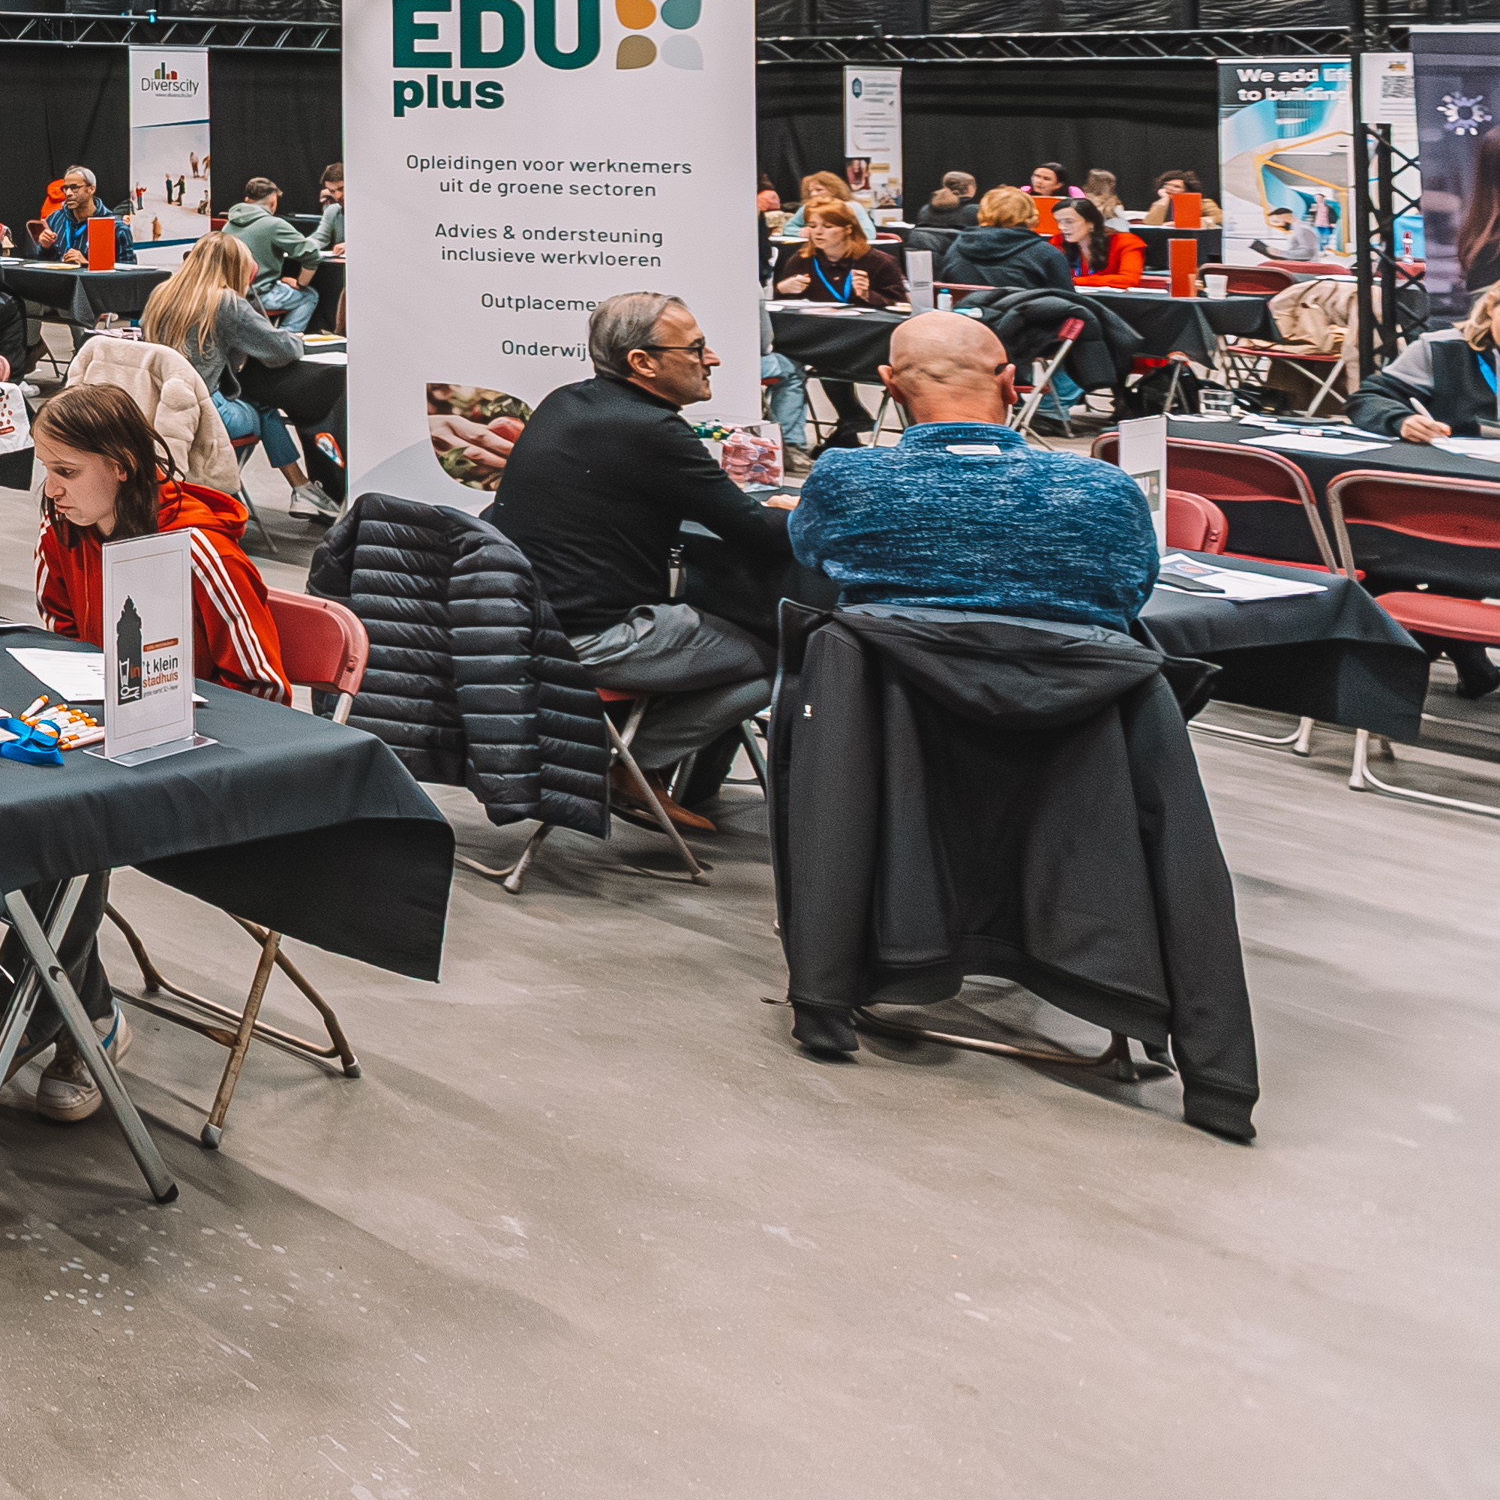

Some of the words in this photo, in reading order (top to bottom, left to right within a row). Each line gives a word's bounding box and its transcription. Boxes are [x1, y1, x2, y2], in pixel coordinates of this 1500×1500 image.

[1236, 68, 1275, 83] We
[1277, 68, 1320, 83] add
[141, 77, 200, 95] Diverscity
[393, 74, 505, 117] plus
[1237, 88, 1263, 102] to
[406, 155, 517, 174] Opleidingen
[522, 159, 565, 173] voor
[569, 158, 692, 175] werknemers
[439, 178, 464, 193] uit
[469, 179, 492, 194] de
[497, 182, 563, 198] groene
[568, 182, 657, 197] sectoren
[434, 223, 498, 240] Advies
[502, 225, 516, 240] &
[521, 226, 663, 248] ondersteuning
[441, 246, 536, 263] inclusieve
[540, 250, 662, 267] werkvloeren
[480, 293, 603, 312] Outplaceme
[501, 339, 588, 362] Onderwij
[131, 664, 140, 679] in
[153, 655, 178, 673] klein
[143, 671, 178, 688] stadhuis
